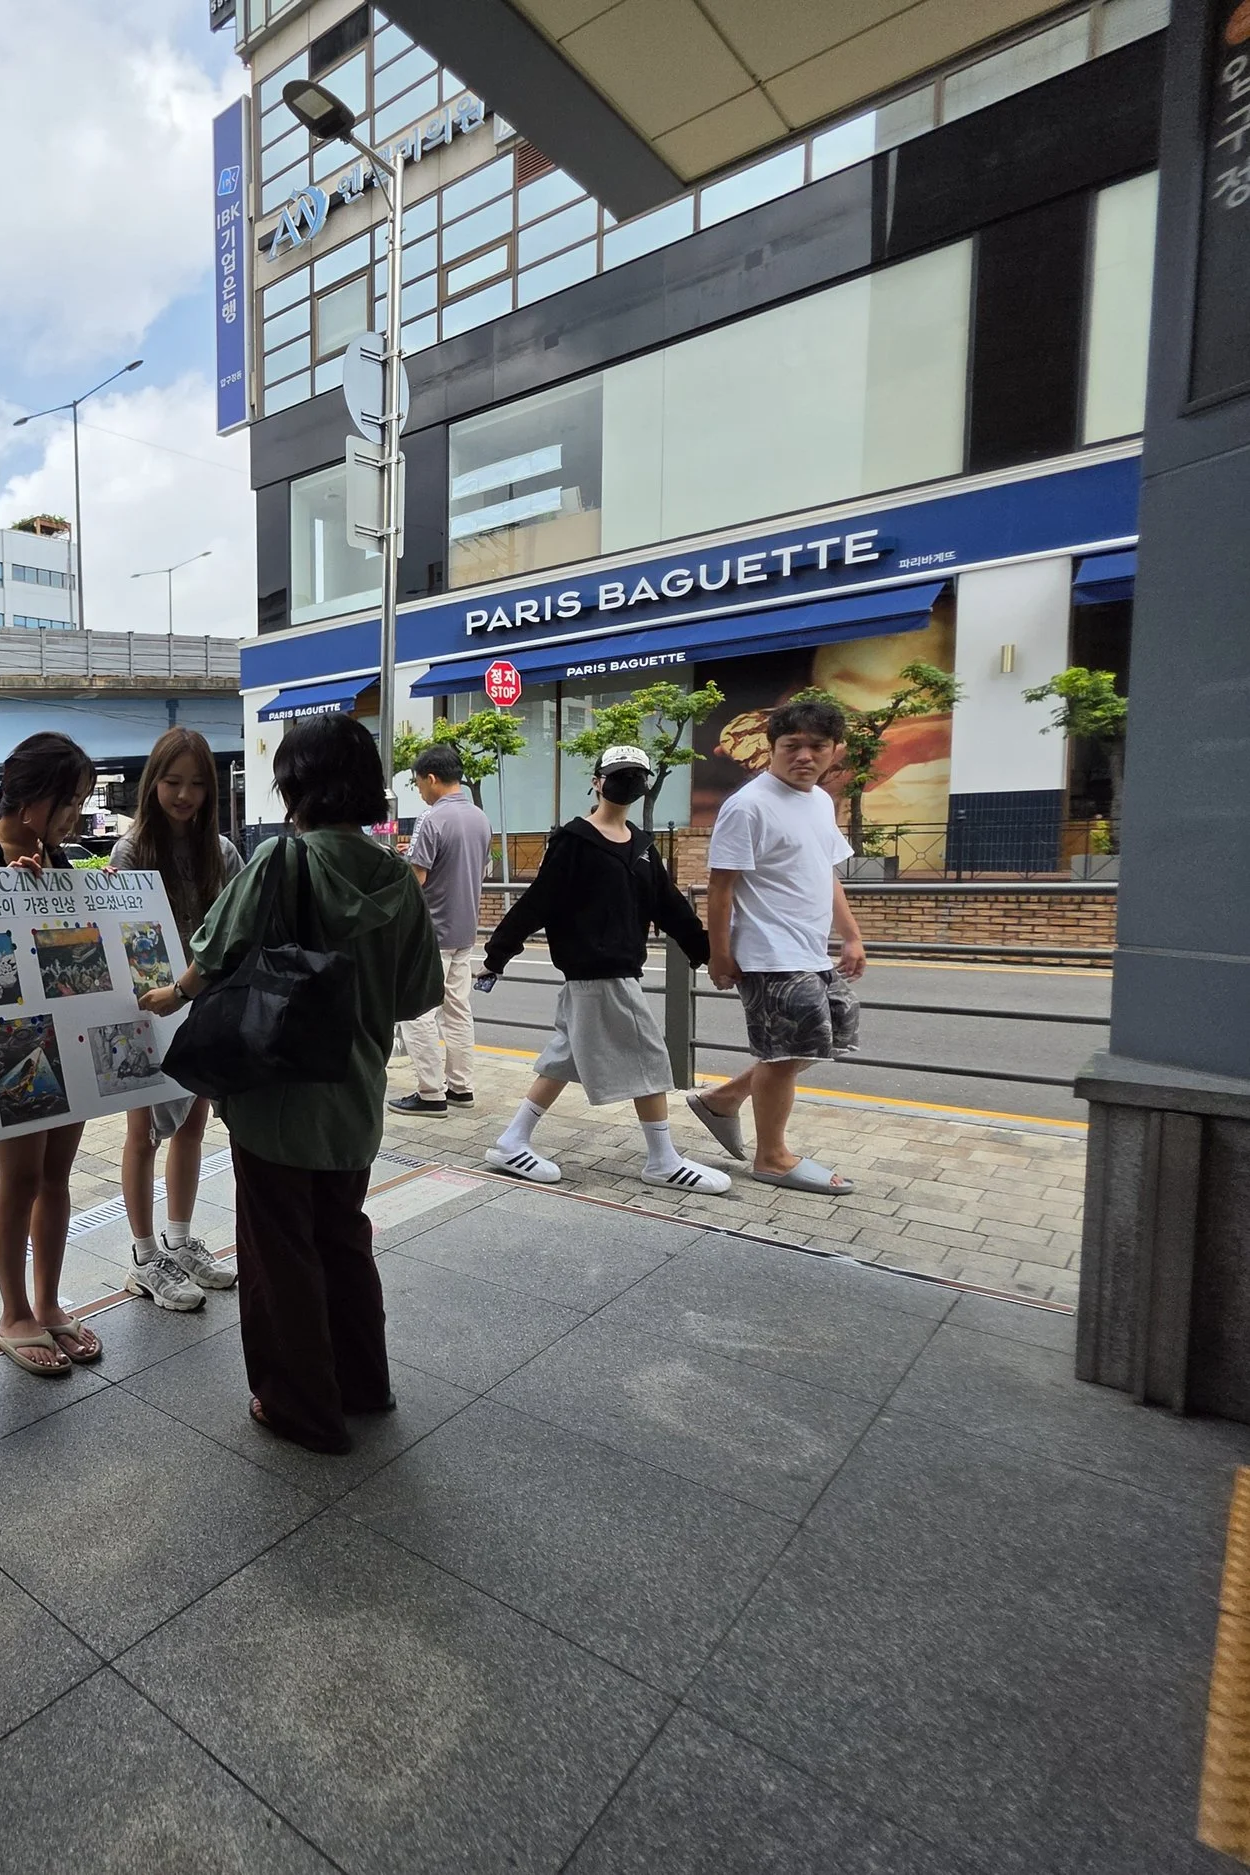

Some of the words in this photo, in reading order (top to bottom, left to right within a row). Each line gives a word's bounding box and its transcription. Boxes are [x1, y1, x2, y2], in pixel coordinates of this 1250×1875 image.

[217, 201, 240, 230] IBK
[221, 225, 237, 324] 기업은행
[897, 550, 957, 570] 파리바게뜨
[465, 591, 581, 635] PARIS
[599, 529, 880, 611] BAGUETTE
[566, 662, 606, 678] PARIS
[610, 651, 686, 671] BAGUETTE
[490, 668, 517, 685] 정지
[490, 685, 517, 700] STOP
[268, 711, 294, 722] PARIS
[294, 702, 341, 718] BAGUETTE
[84, 872, 154, 891] SOCIETY
[23, 896, 49, 915] 가장
[51, 896, 76, 914] 인상
[83, 894, 143, 912] 깊으셨나요?
